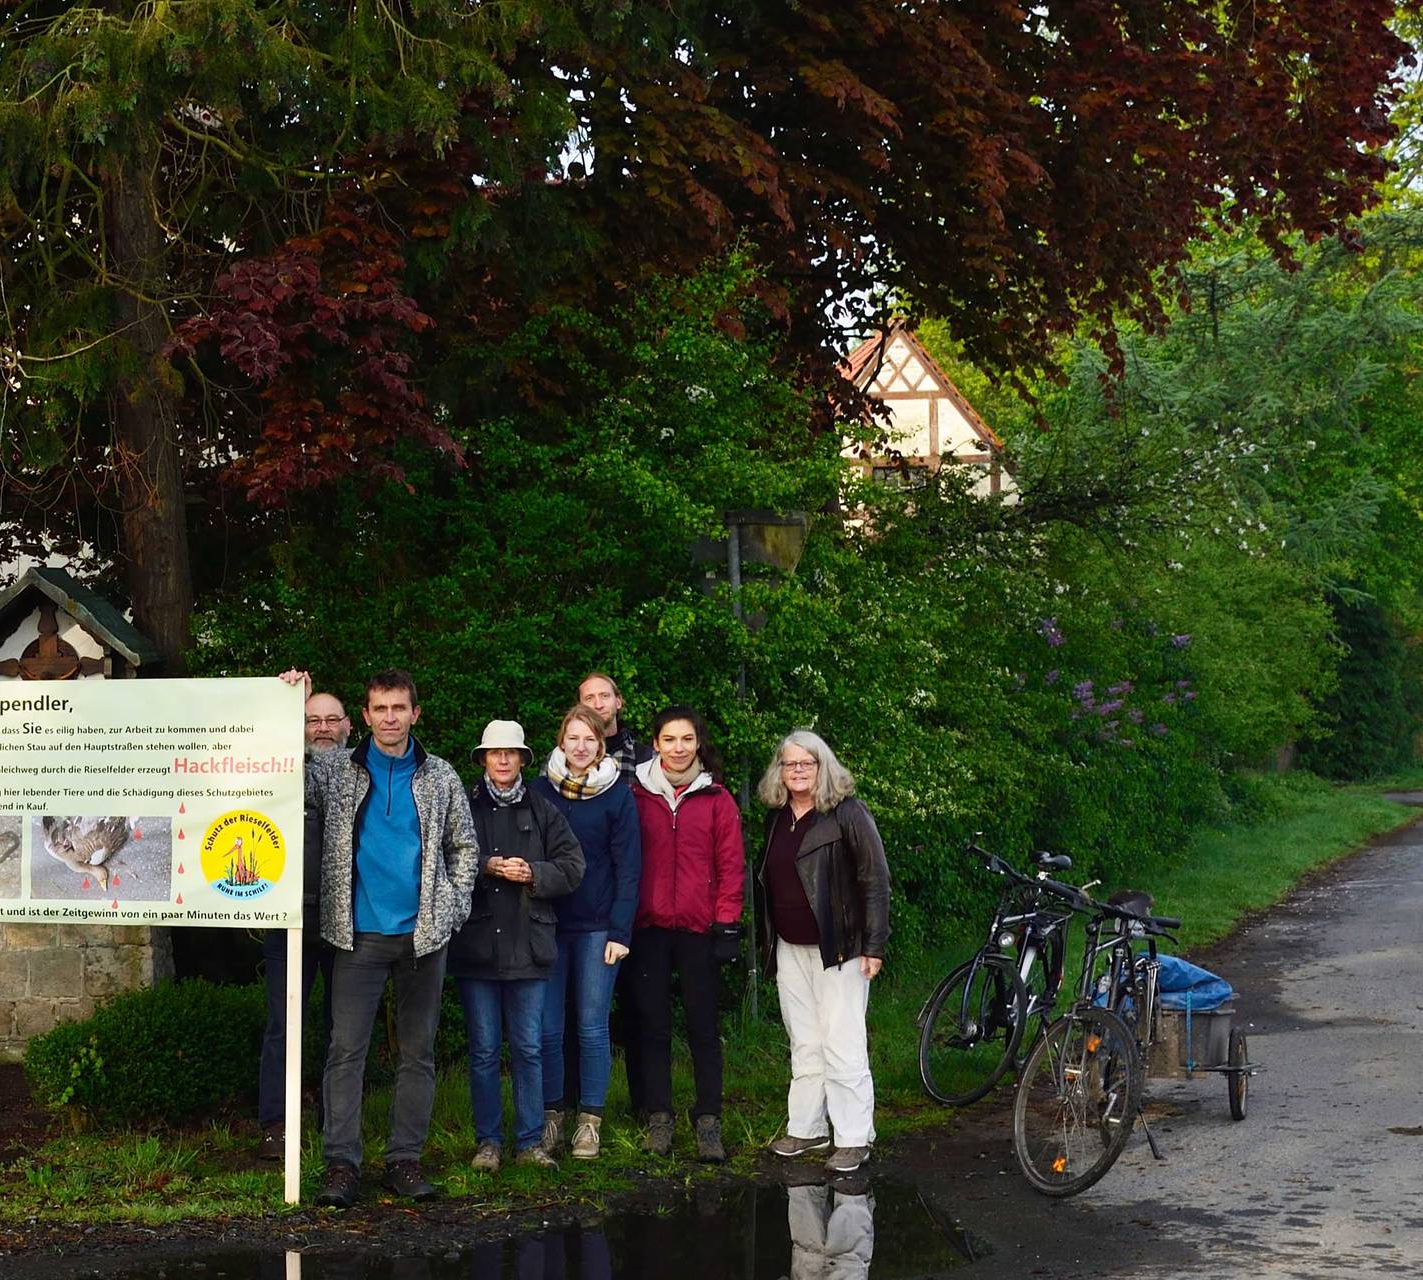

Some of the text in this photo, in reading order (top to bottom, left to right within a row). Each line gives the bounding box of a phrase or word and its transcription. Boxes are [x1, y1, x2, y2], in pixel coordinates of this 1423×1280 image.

[1, 726, 19, 734] dass
[22, 722, 42, 734] Sie
[56, 725, 74, 736] eilig
[76, 725, 106, 735] haben,
[125, 724, 152, 734] Arbeit
[167, 724, 206, 734] kommen
[208, 724, 226, 734] und
[228, 724, 253, 733] dabei
[26, 742, 46, 751] Stau
[48, 742, 63, 751] auf
[65, 742, 81, 751] den
[83, 741, 143, 752] Hauptstraßen
[145, 741, 175, 751] stehen
[177, 741, 209, 751] wollen,
[211, 741, 231, 750] aber
[41, 765, 66, 774] durch
[68, 765, 82, 774] die
[84, 765, 136, 774] Rieselfelder
[137, 766, 171, 777] erzeugt
[174, 757, 295, 774] Hackfleisch!!
[3, 787, 20, 796] hier
[22, 787, 60, 796] lebender
[63, 787, 85, 796] Tiere
[87, 787, 104, 796] und
[106, 787, 120, 796] die
[122, 786, 174, 799] Schädigung
[176, 787, 204, 796] dieses
[206, 787, 273, 799] Schutzgebietes
[15, 801, 24, 810] in
[26, 801, 48, 810] Kauf.
[205, 814, 280, 851] Schutz der Rieselfelder
[217, 883, 234, 896] RUHE
[245, 883, 269, 897] SCHILF!
[7, 907, 26, 916] und
[28, 907, 41, 917] ist
[43, 908, 60, 917] der
[62, 908, 118, 920] Zeitgewinn
[120, 911, 140, 919] von
[142, 910, 158, 919] ein
[161, 912, 185, 922] paar
[187, 910, 231, 920] Minuten
[233, 911, 252, 921] das
[253, 912, 280, 921] Wert
[282, 911, 288, 922] ?
